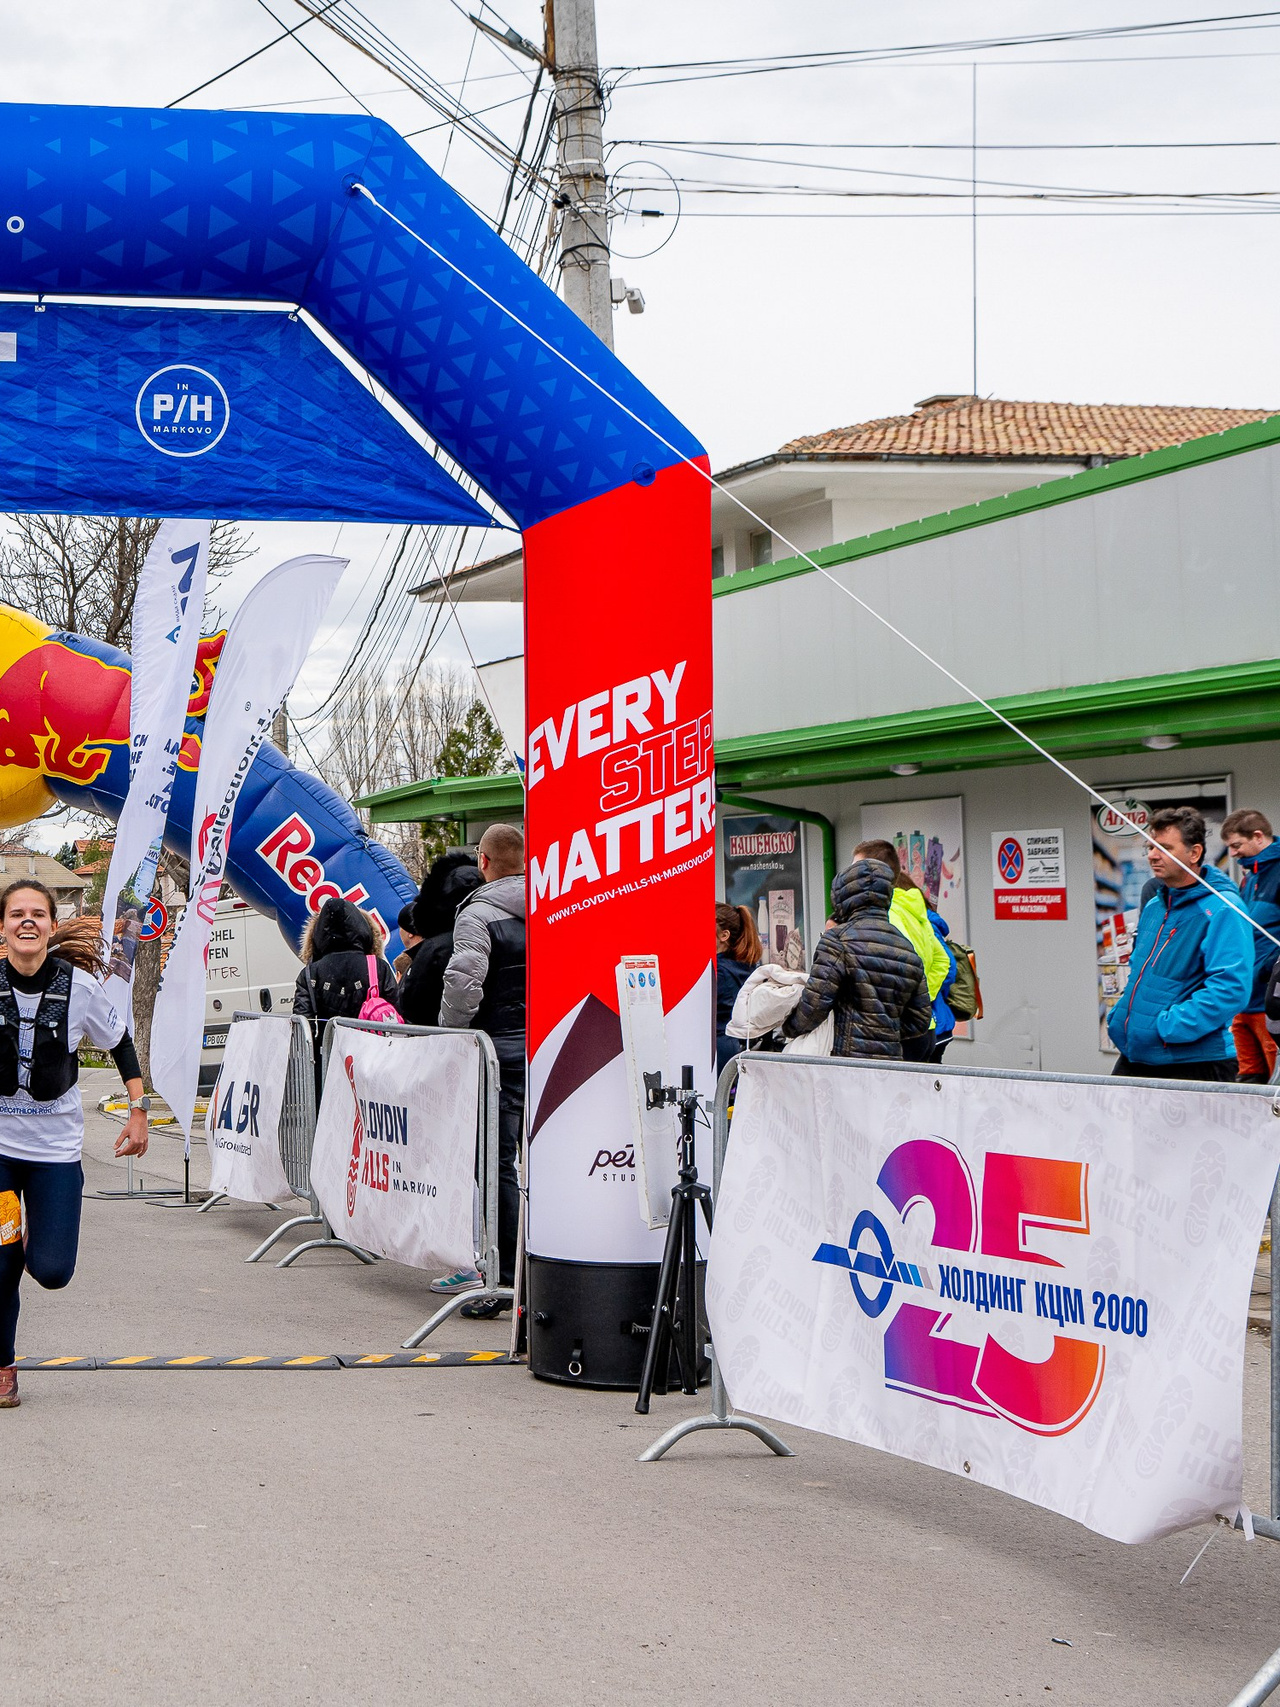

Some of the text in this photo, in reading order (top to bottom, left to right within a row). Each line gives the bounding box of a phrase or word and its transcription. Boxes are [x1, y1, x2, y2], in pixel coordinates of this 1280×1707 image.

[153, 394, 213, 423] P/H
[153, 425, 213, 435] MARKOVO
[528, 660, 687, 791] EVERY
[599, 708, 713, 813] STEP
[730, 832, 795, 856] НАШЕНСКО
[546, 846, 714, 925] WWW.PLOVDIV-HILLS-IN-MARKOVO.COM
[207, 967, 241, 980] ITER
[393, 1161, 401, 1173] IN
[393, 1179, 437, 1198] MARKOVO
[938, 1264, 1149, 1338] ХОЛДИНГ КЦМ 2000
